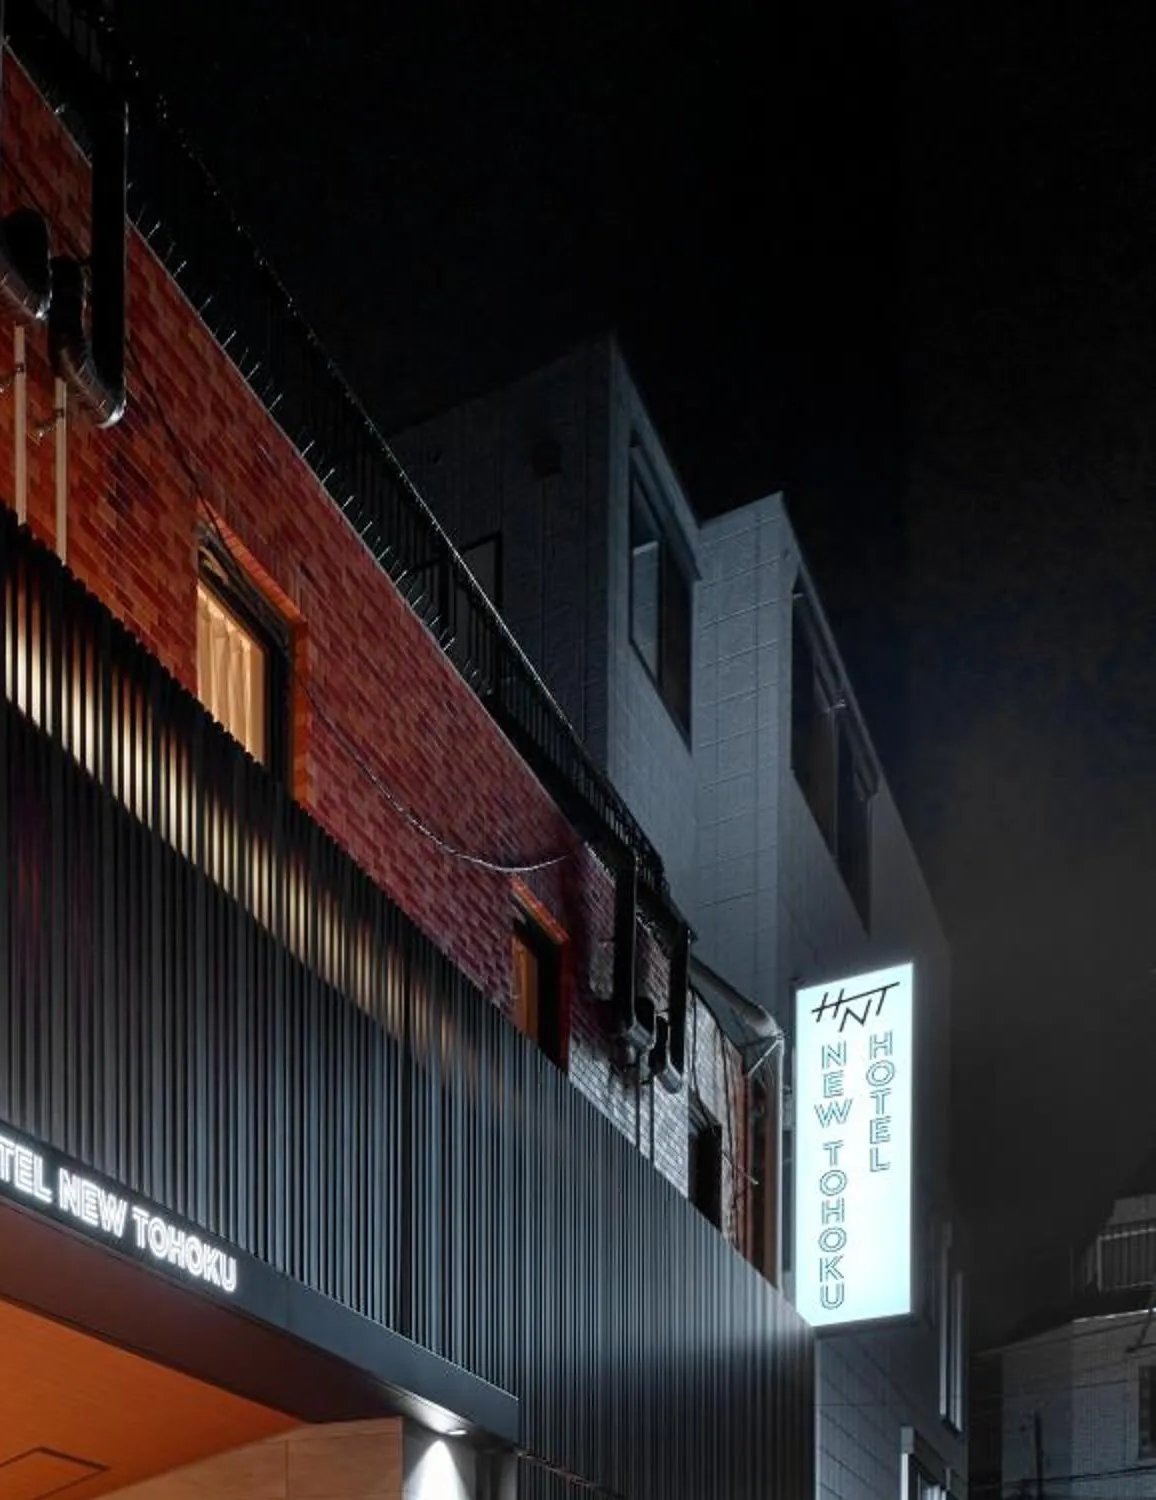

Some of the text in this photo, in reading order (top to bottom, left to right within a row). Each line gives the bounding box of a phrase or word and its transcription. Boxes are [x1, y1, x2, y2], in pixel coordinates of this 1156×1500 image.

[865, 1030, 895, 1174] HOTEL
[58, 1167, 128, 1237] NEW
[132, 1205, 238, 1293] TOHOKU
[813, 1039, 853, 1310] NEW TOHOKU
